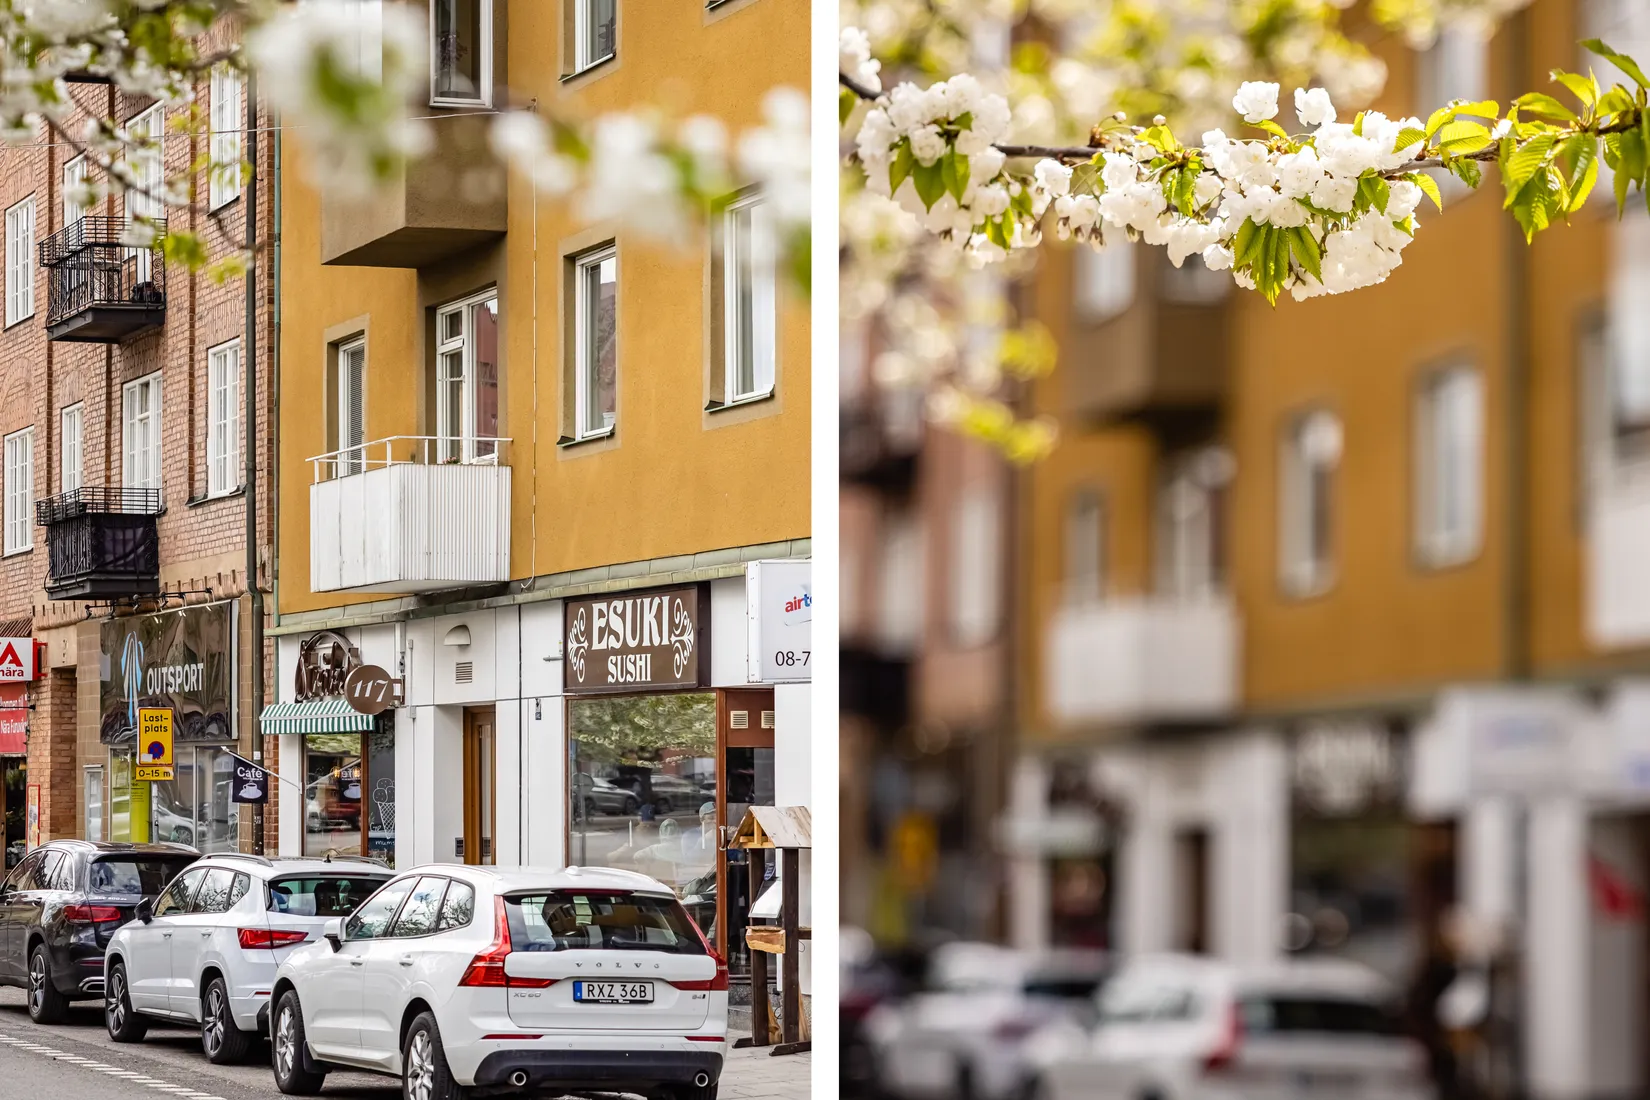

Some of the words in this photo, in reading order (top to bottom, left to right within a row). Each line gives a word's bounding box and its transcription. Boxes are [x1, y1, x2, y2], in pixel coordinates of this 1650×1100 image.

[591, 595, 670, 650] ESUKI
[775, 650, 811, 666] 08-7
[608, 653, 651, 684] SUSHI
[146, 662, 204, 695] OUTSPORT
[352, 679, 389, 702] 117
[143, 713, 169, 722] Last-
[144, 723, 168, 734] plats
[138, 769, 160, 777] 0-15
[237, 766, 263, 778] Café
[575, 961, 660, 970] VOLVO
[587, 984, 615, 998] RXZ
[620, 984, 647, 999] 36B
